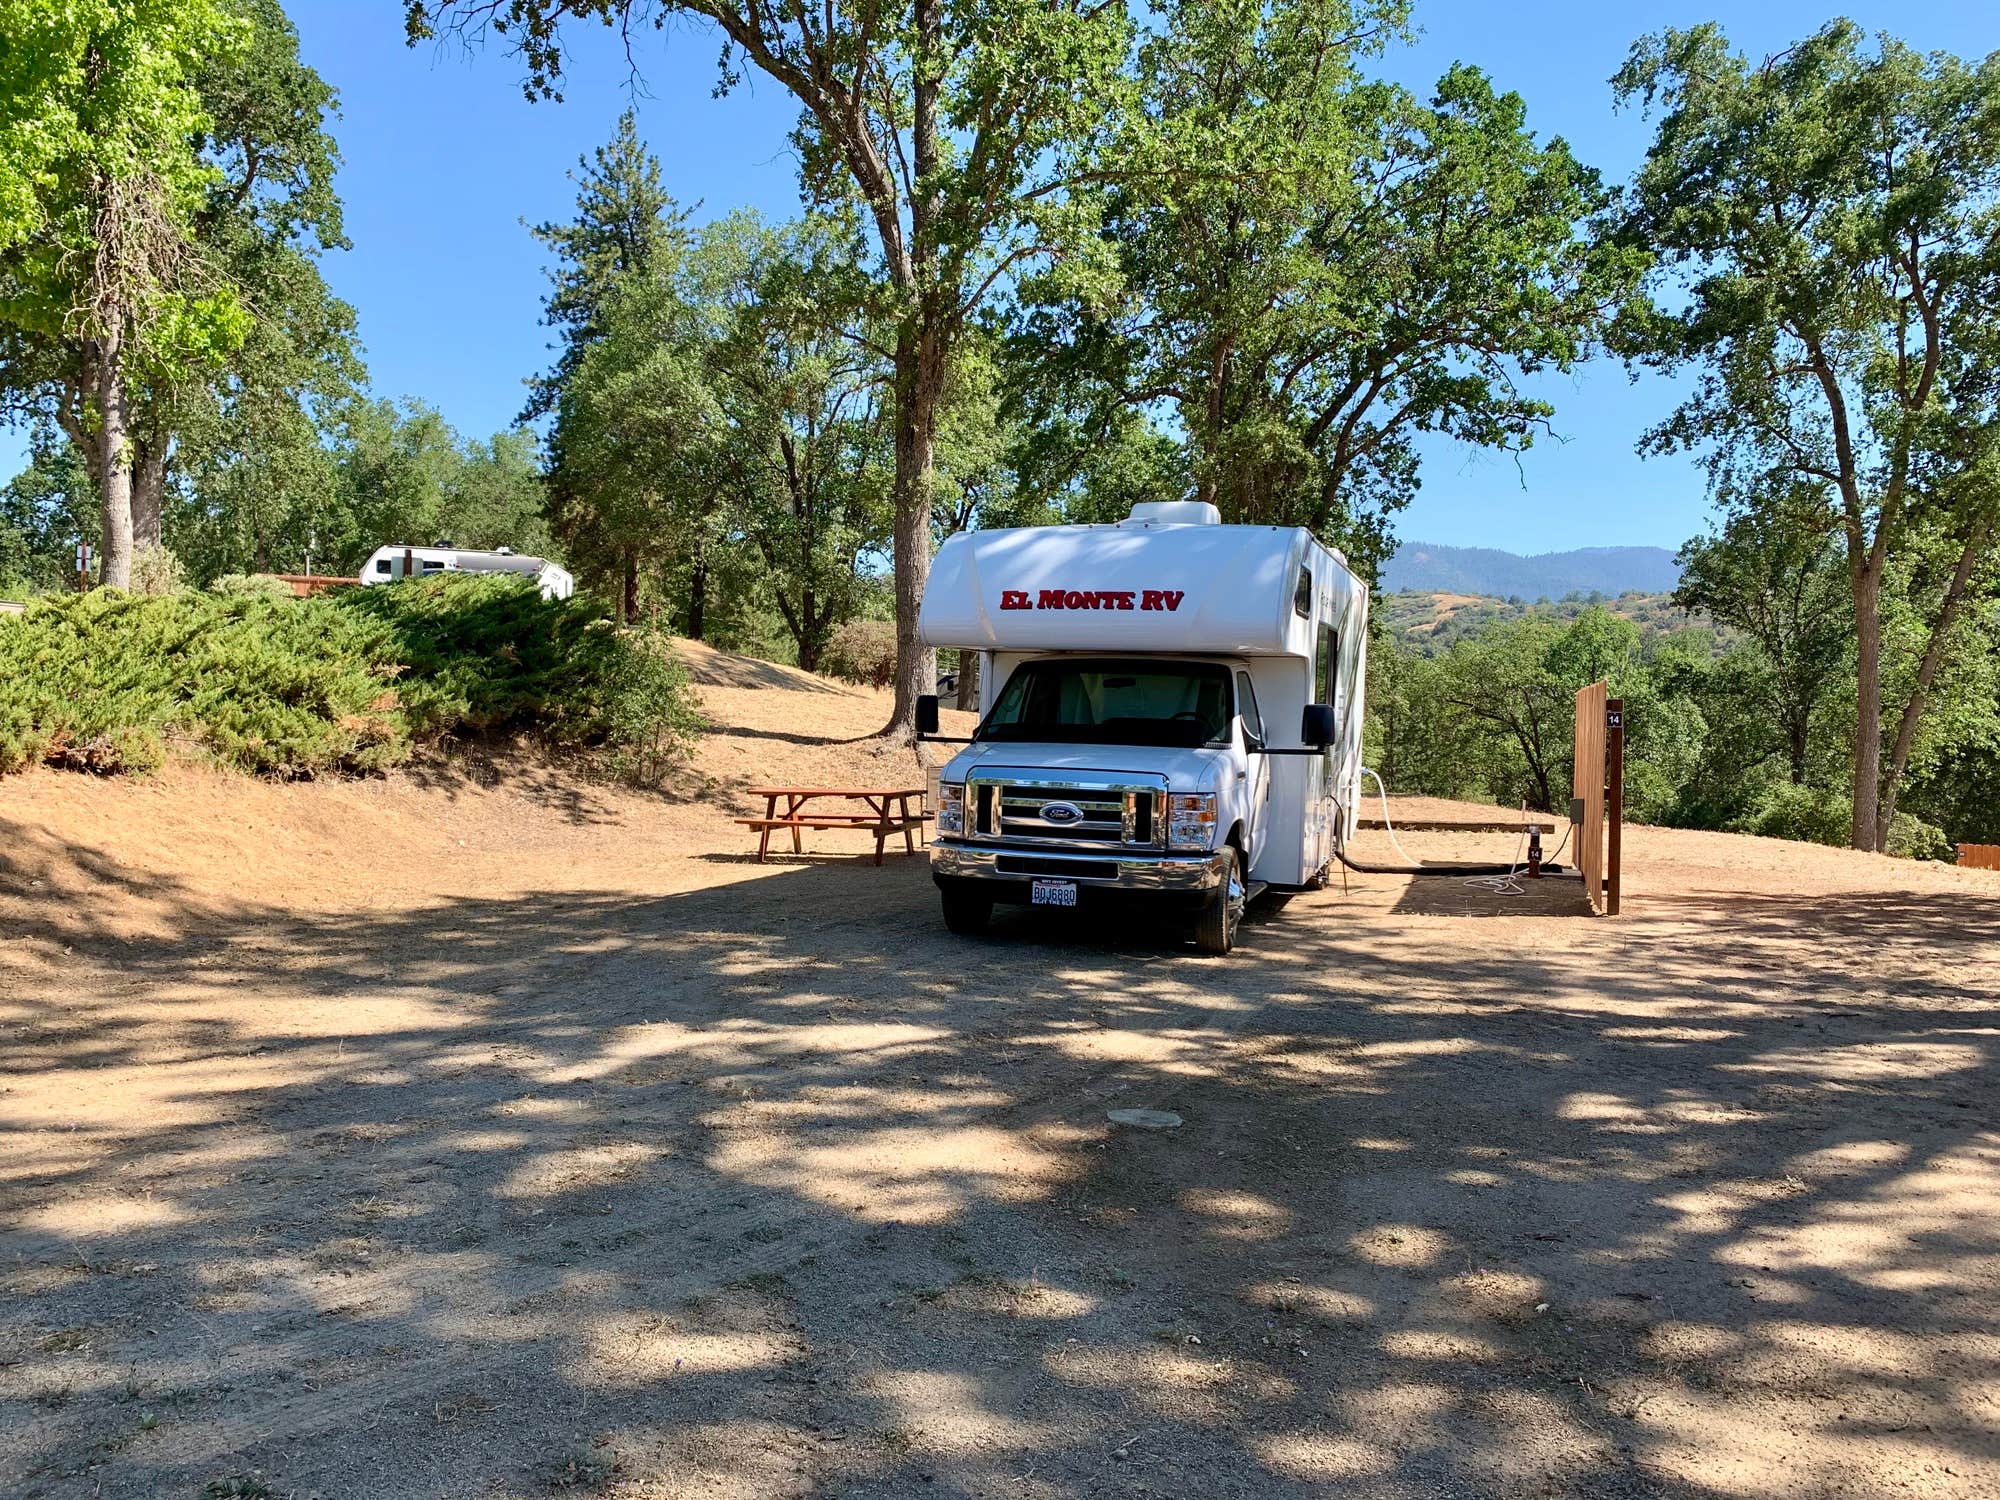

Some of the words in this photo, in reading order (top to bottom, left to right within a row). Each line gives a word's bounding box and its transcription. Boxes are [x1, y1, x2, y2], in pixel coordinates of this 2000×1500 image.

[1140, 590, 1184, 611] RV
[1609, 715, 1619, 724] 14
[1050, 808, 1070, 819] Ford
